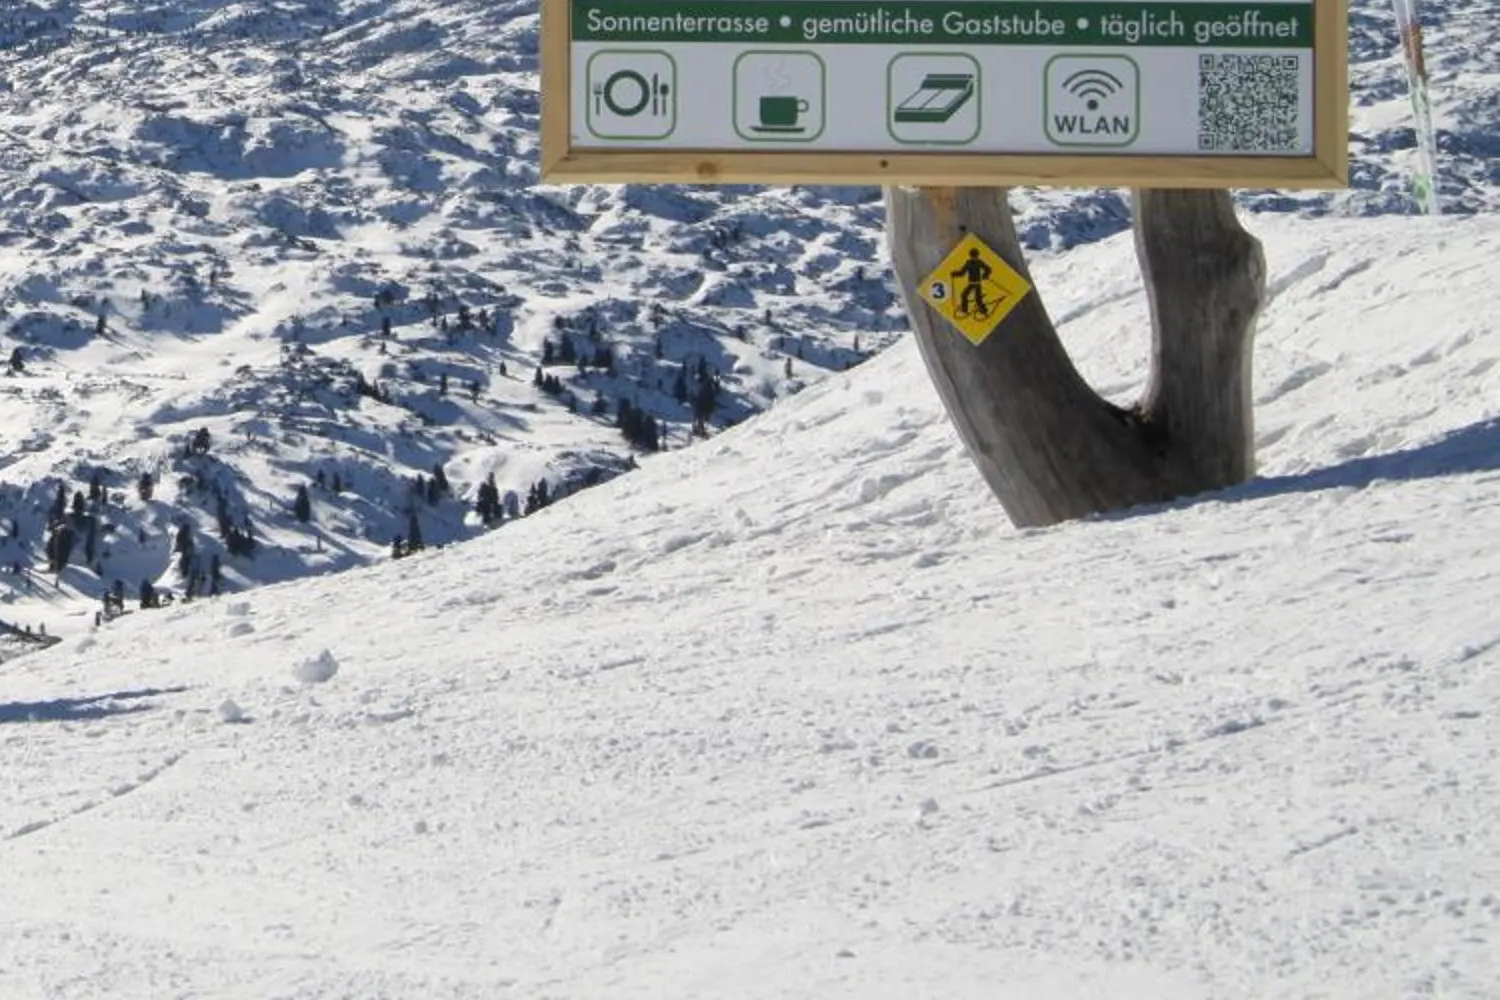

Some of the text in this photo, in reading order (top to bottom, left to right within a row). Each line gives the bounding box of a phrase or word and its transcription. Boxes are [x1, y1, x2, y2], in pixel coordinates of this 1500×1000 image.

[587, 8, 1300, 44] Sonnenterrasse gemütliche Gaststube täglich geöffnet
[1053, 114, 1130, 136] WLAN
[931, 282, 946, 299] 3
